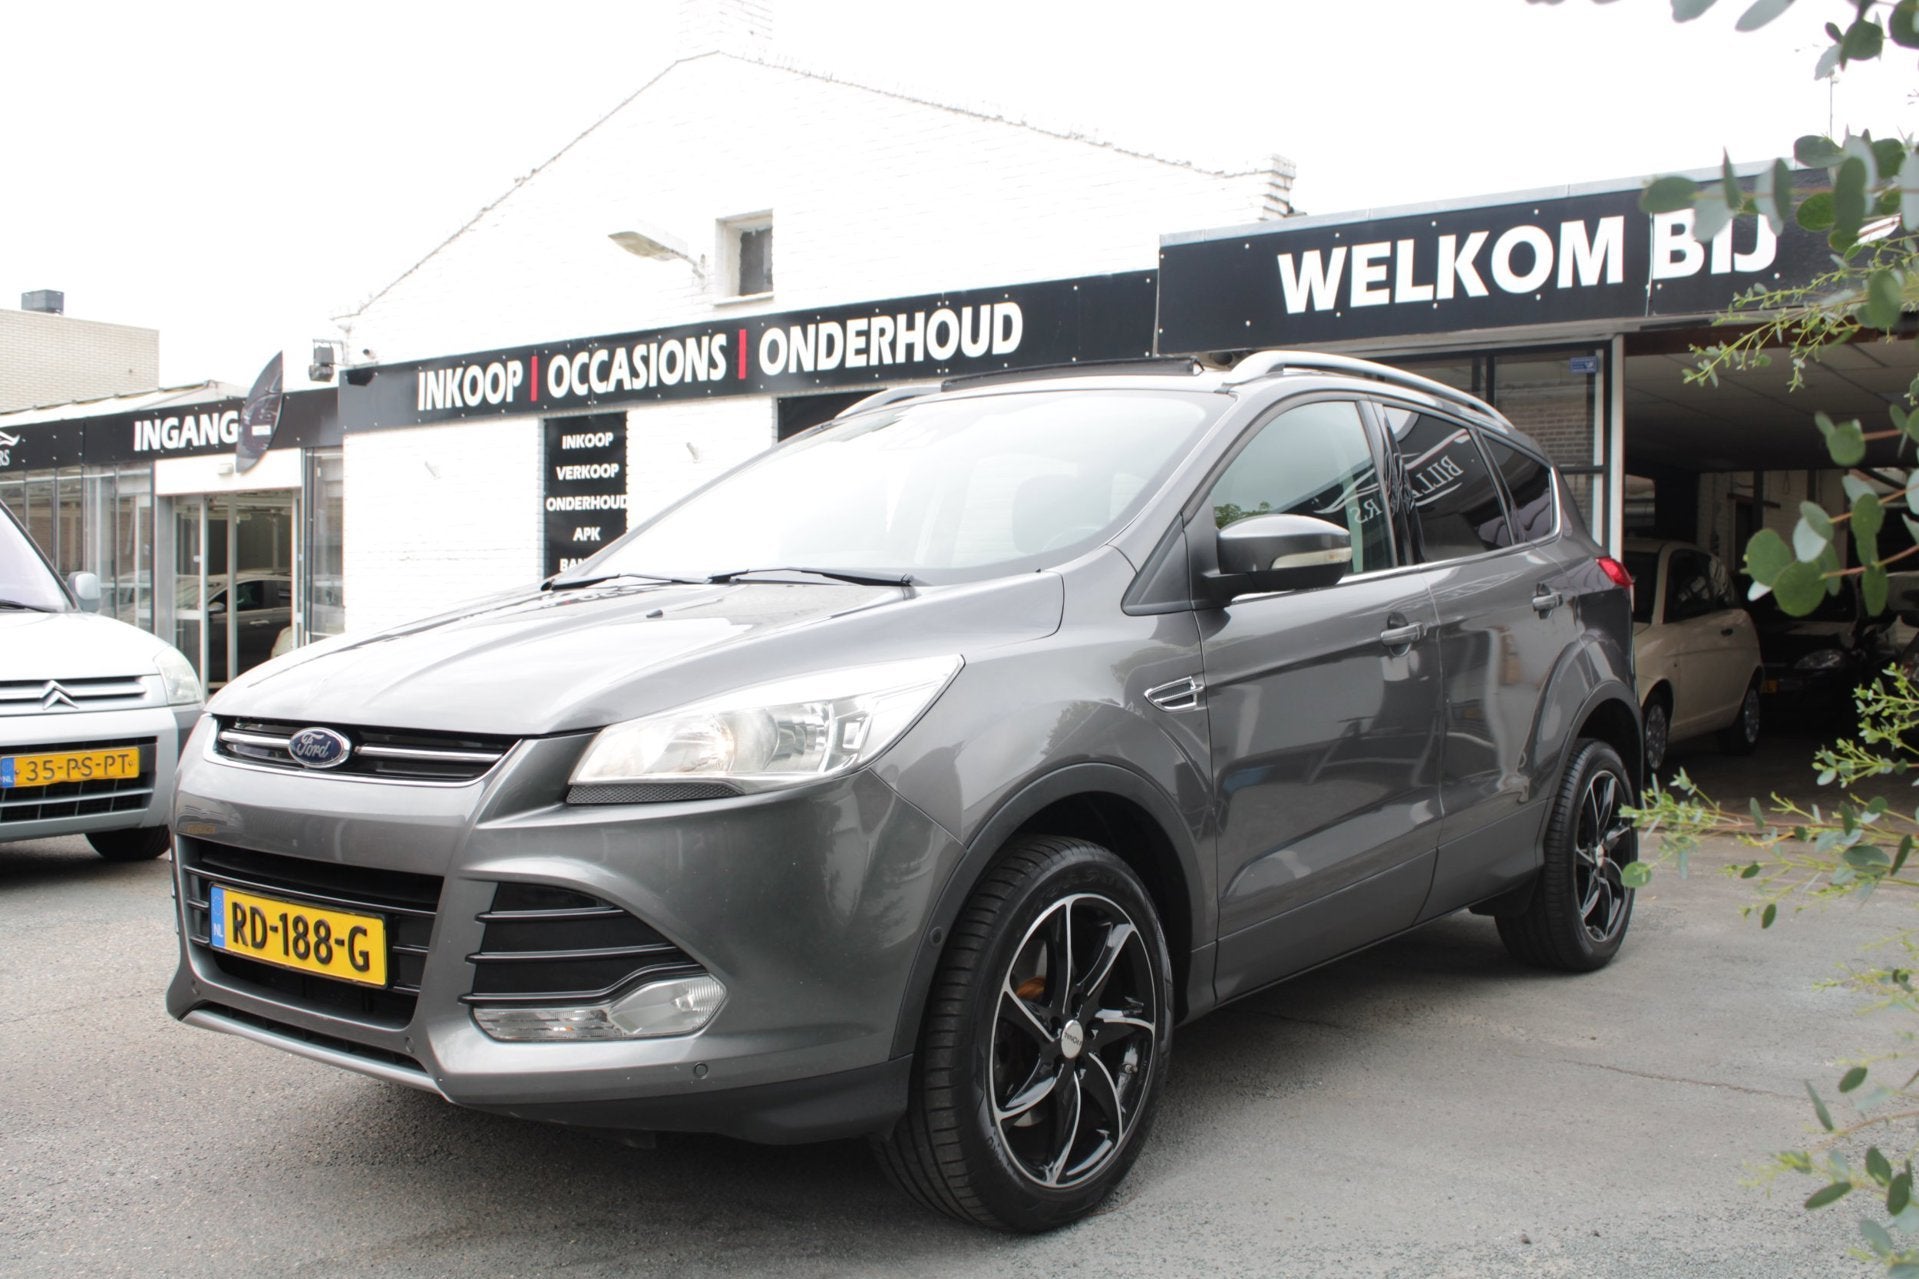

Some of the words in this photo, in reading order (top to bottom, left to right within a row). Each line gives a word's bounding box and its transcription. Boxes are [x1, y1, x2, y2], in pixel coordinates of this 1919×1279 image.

[1277, 215, 1624, 314] WELKOM
[1652, 207, 1777, 280] BIJ
[417, 360, 523, 411] INKOOP
[547, 333, 727, 399] OCCASIONS
[758, 302, 1023, 377] ONDERHOUD
[134, 411, 240, 452] INGANG
[562, 432, 613, 450] INKOOP
[556, 464, 619, 481] VERKOOP
[546, 494, 627, 511] ONDERHOUD
[572, 527, 601, 541] APK
[296, 732, 331, 758] Ford
[26, 754, 129, 782] 35-PS-PT
[213, 922, 224, 938] NL
[231, 901, 371, 973] RD-188-G
